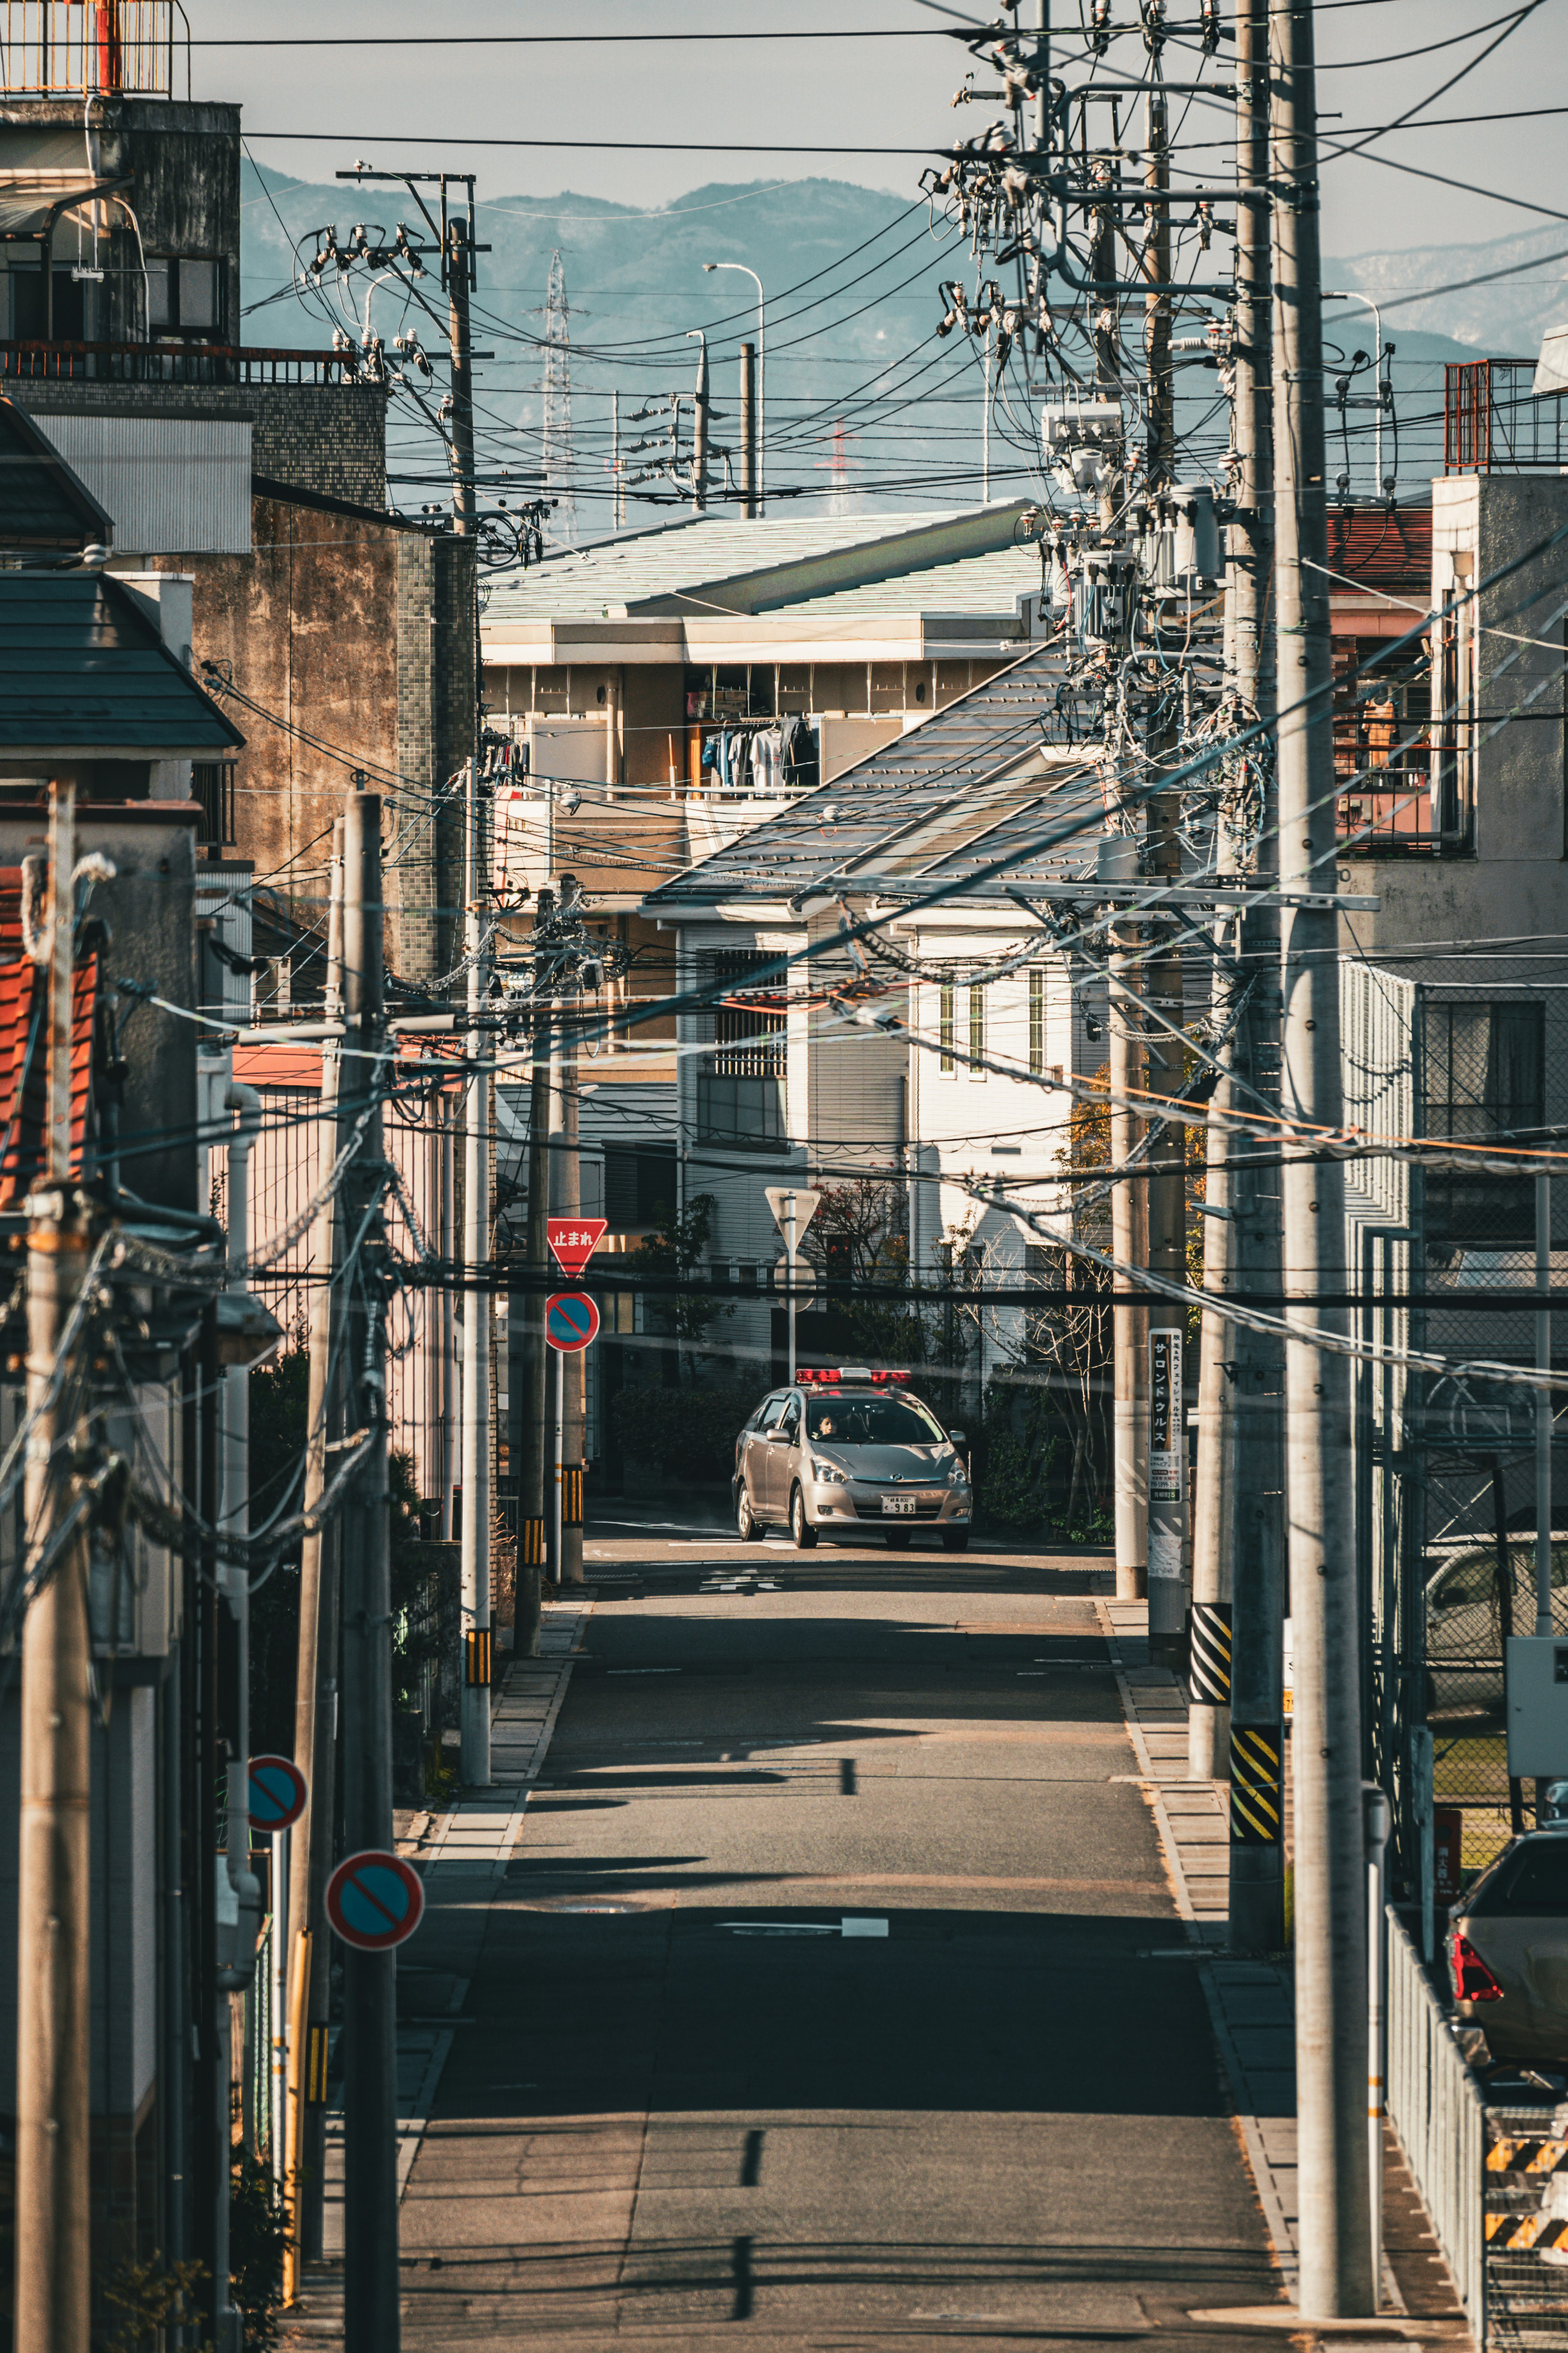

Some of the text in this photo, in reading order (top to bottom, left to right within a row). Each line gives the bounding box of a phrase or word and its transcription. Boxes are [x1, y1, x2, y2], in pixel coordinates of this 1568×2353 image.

[553, 1231, 593, 1247] 止まれ
[1155, 1343, 1167, 1442] サロンドウルス
